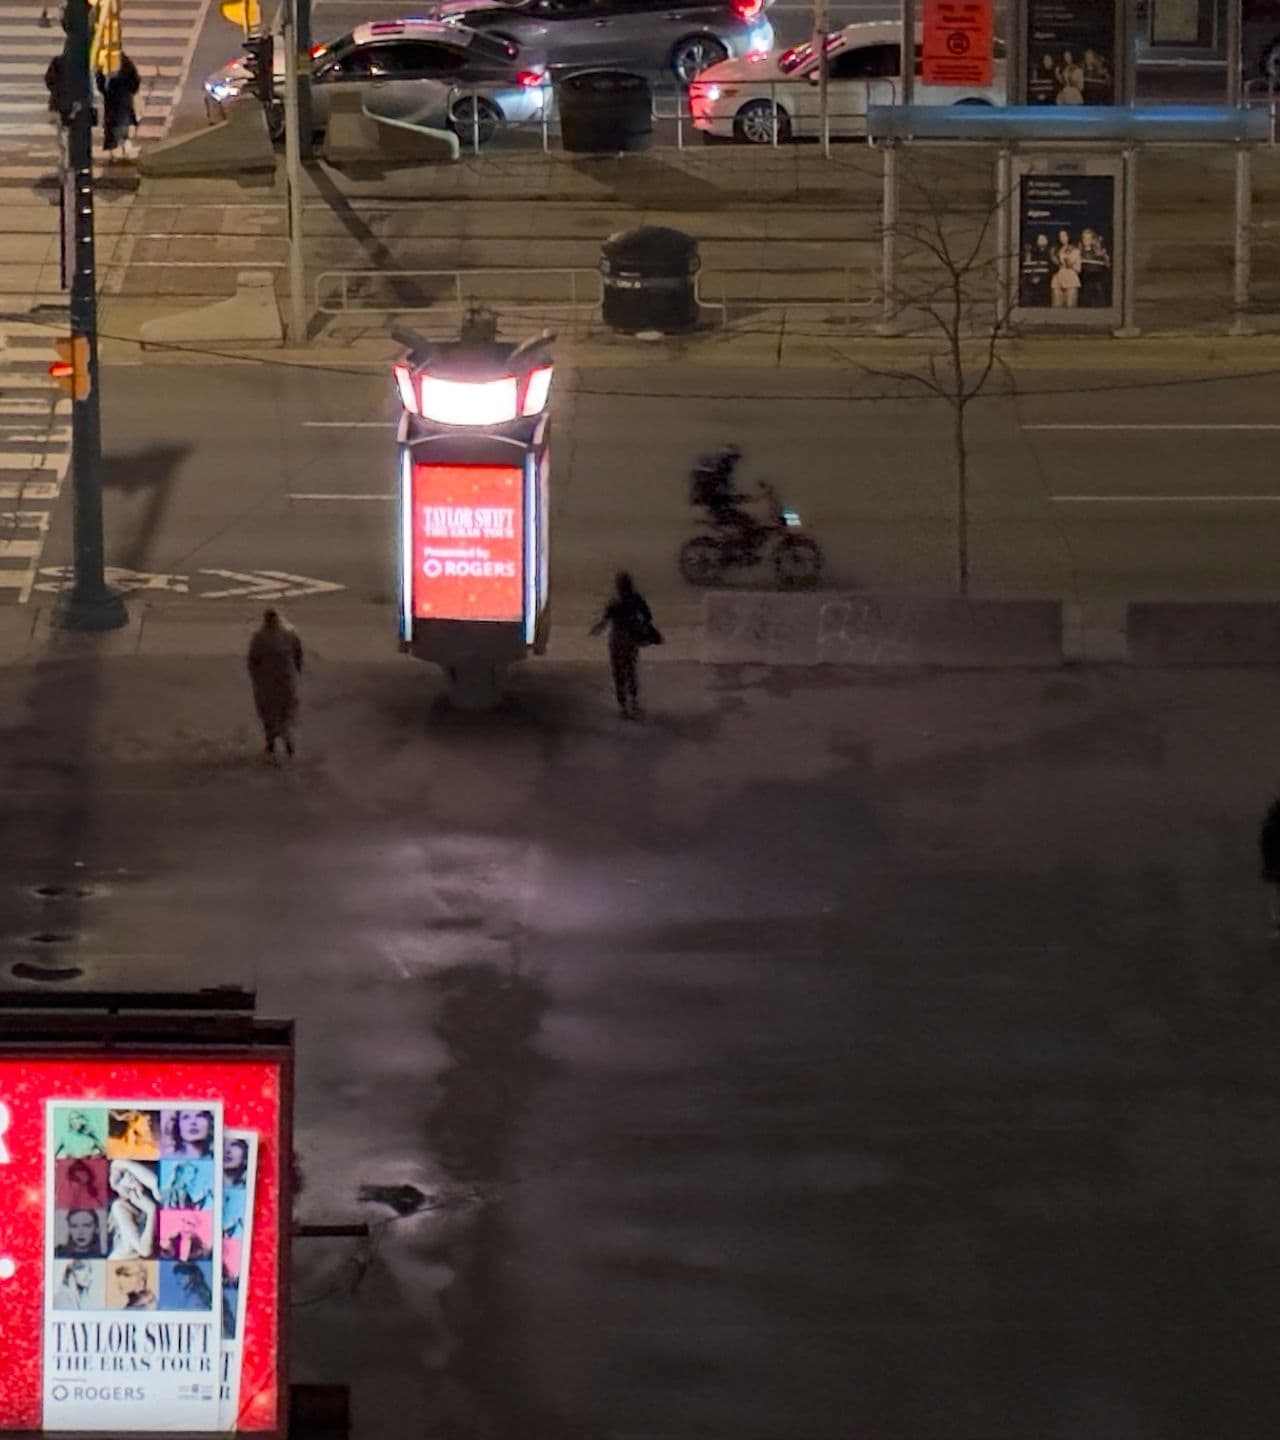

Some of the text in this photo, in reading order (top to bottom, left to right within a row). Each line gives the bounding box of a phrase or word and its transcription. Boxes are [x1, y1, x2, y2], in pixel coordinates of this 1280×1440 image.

[475, 507, 515, 529] SWIFT
[445, 561, 515, 577] ROGERS
[52, 1321, 213, 1354] TAYLOR SWIFT
[53, 1356, 92, 1372] THE
[100, 1356, 151, 1372] ERAS
[160, 1356, 212, 1372] TOUR
[74, 1385, 145, 1401] ROGERS
